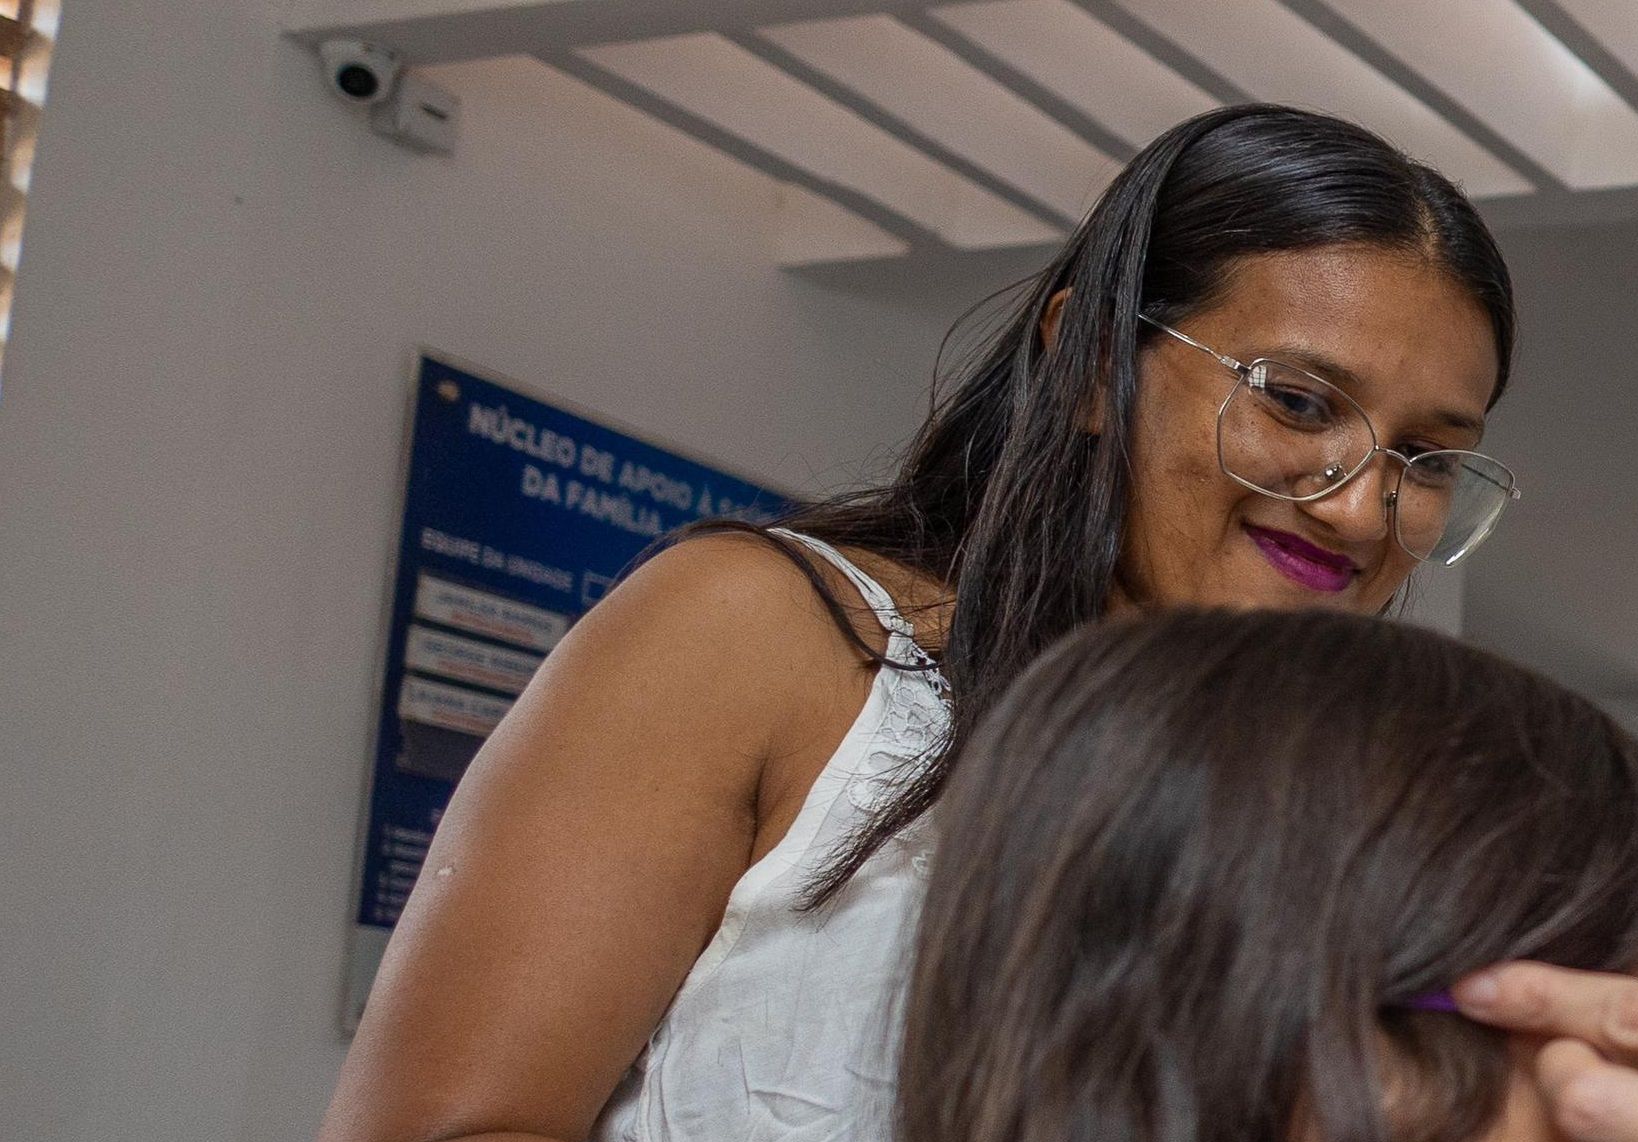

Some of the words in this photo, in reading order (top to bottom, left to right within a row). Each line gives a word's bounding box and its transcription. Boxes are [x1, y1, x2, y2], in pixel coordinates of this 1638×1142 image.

[468, 402, 576, 469] NÚCLEO
[580, 444, 614, 484] DE
[619, 460, 693, 511] APOIO
[521, 464, 562, 504] DA
[565, 480, 662, 536] FAMÍLIA
